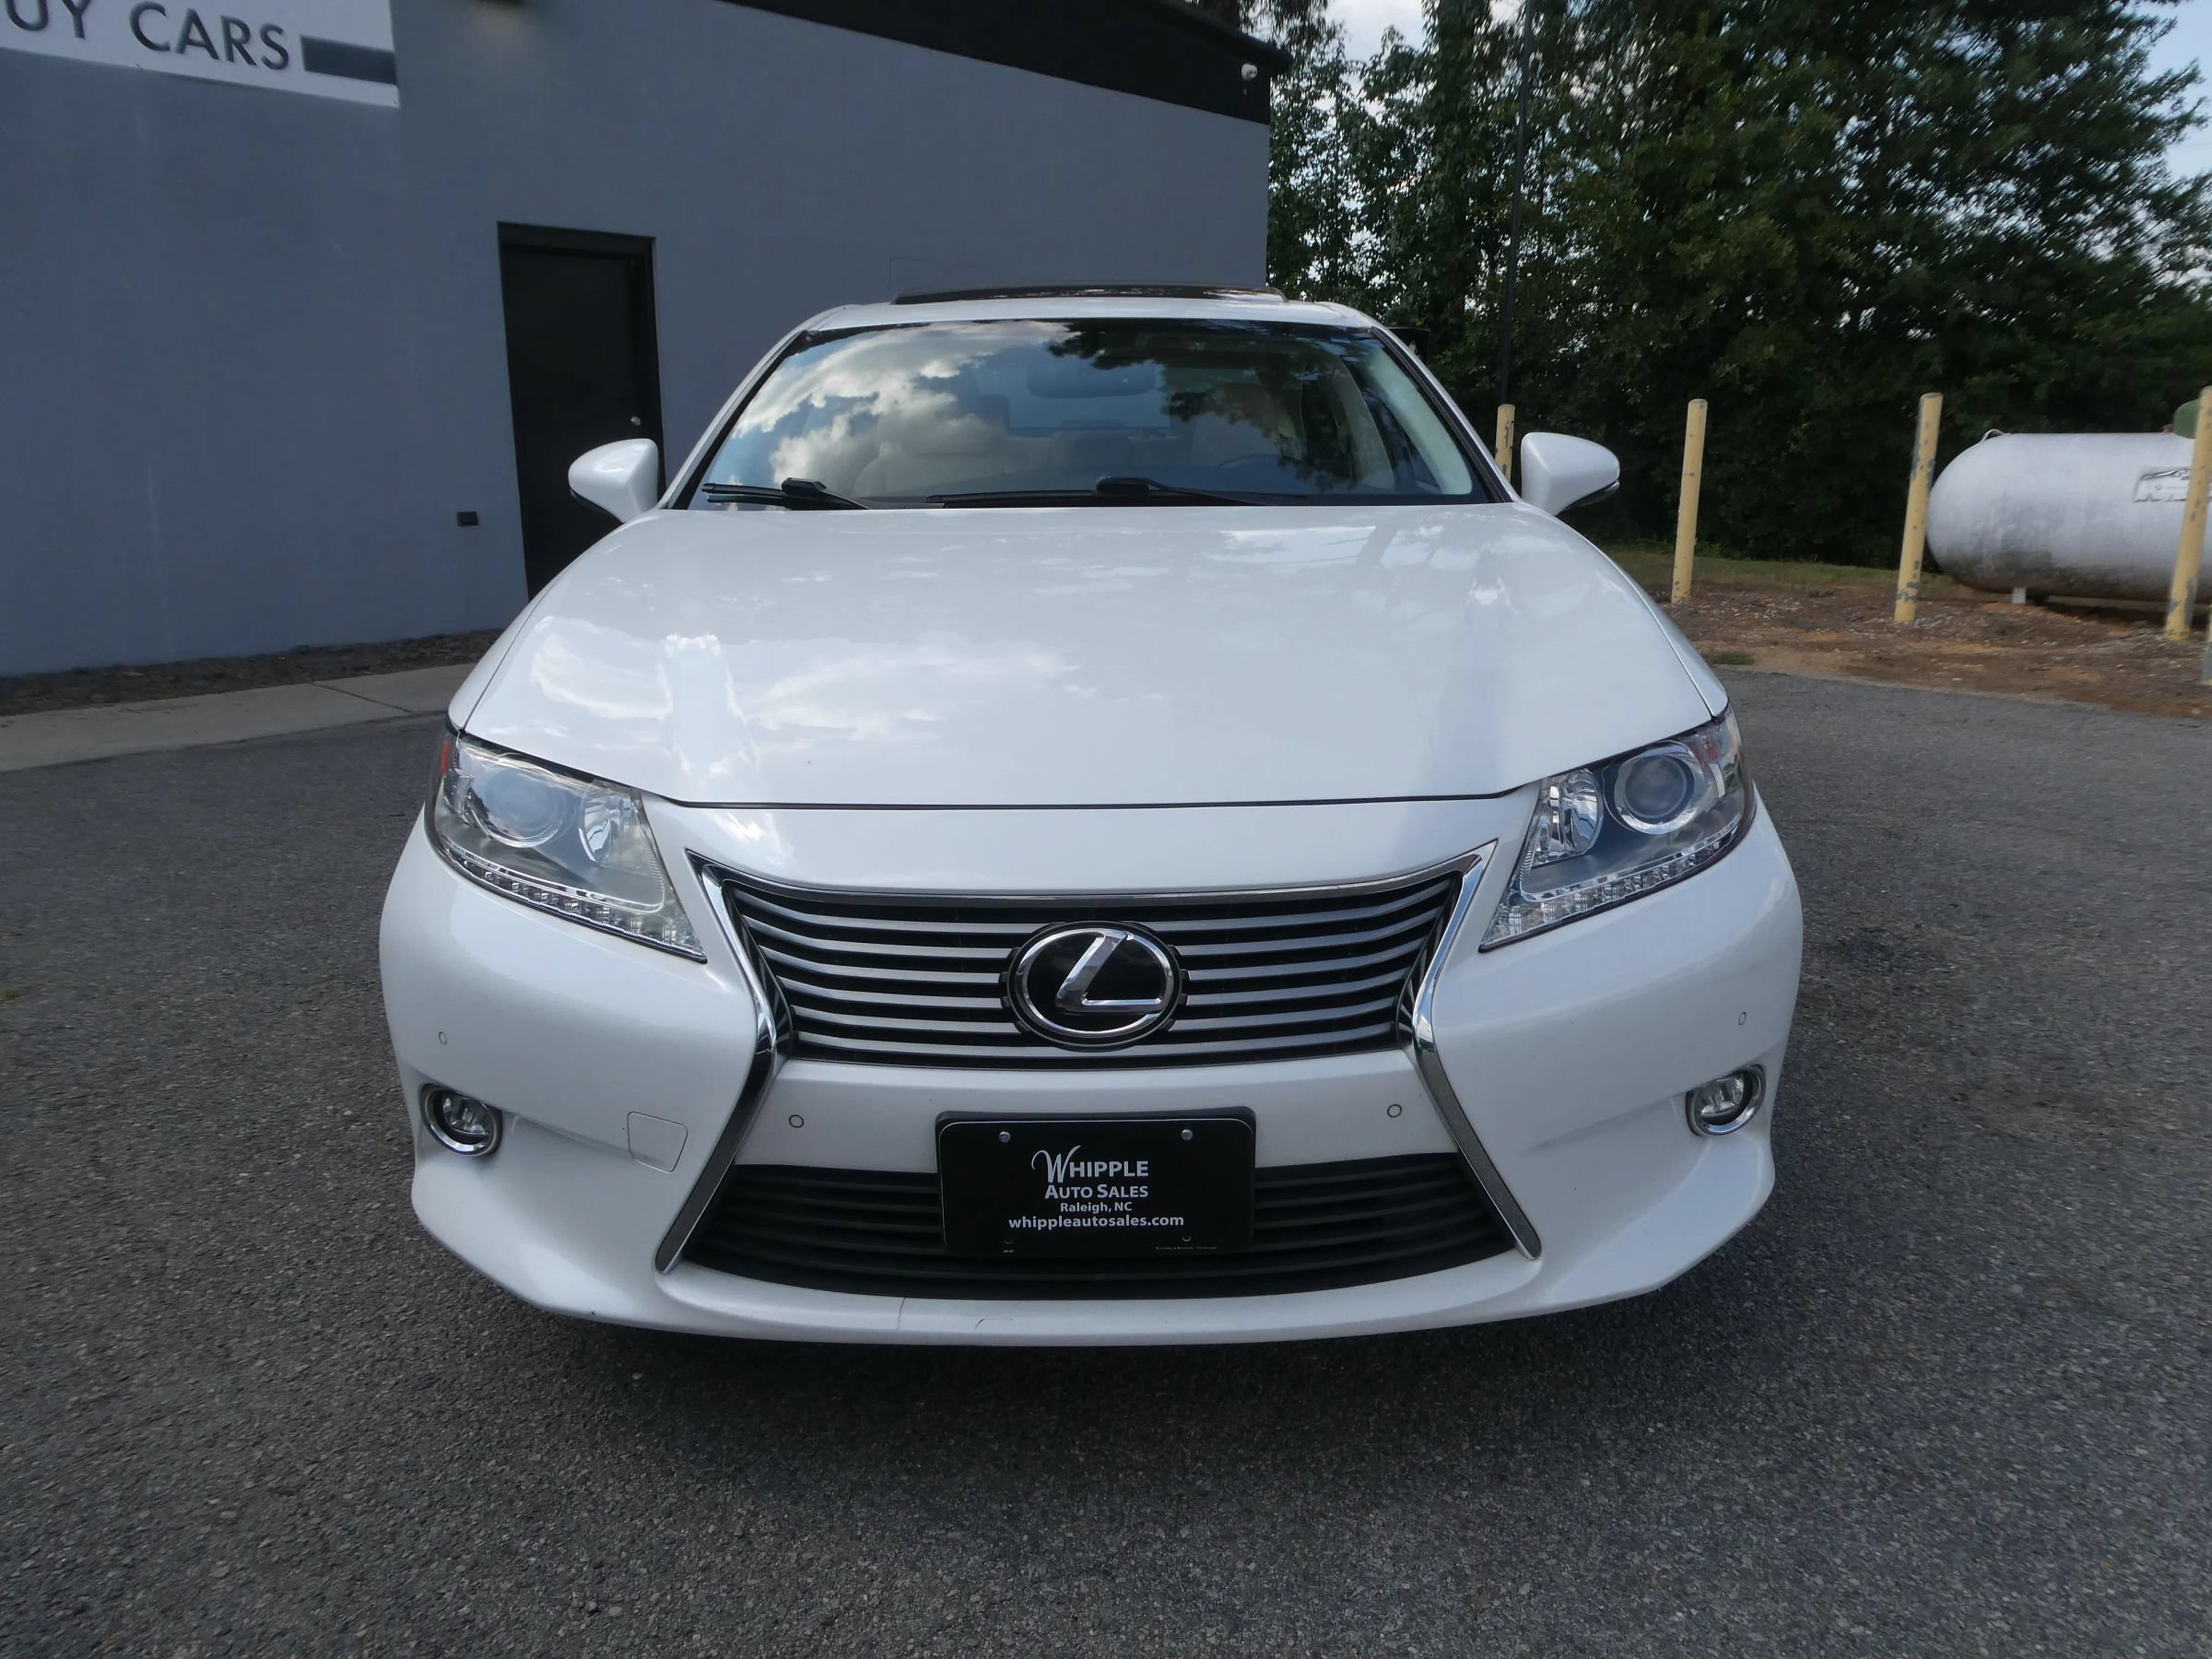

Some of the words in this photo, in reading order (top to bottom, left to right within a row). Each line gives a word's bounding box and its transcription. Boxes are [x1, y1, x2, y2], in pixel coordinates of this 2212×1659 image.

[129, 1, 290, 71] CARS
[1060, 1202, 1112, 1214] Raleigh,
[1114, 1201, 1133, 1212] NC
[1008, 1214, 1184, 1230] whippleautosales.com
